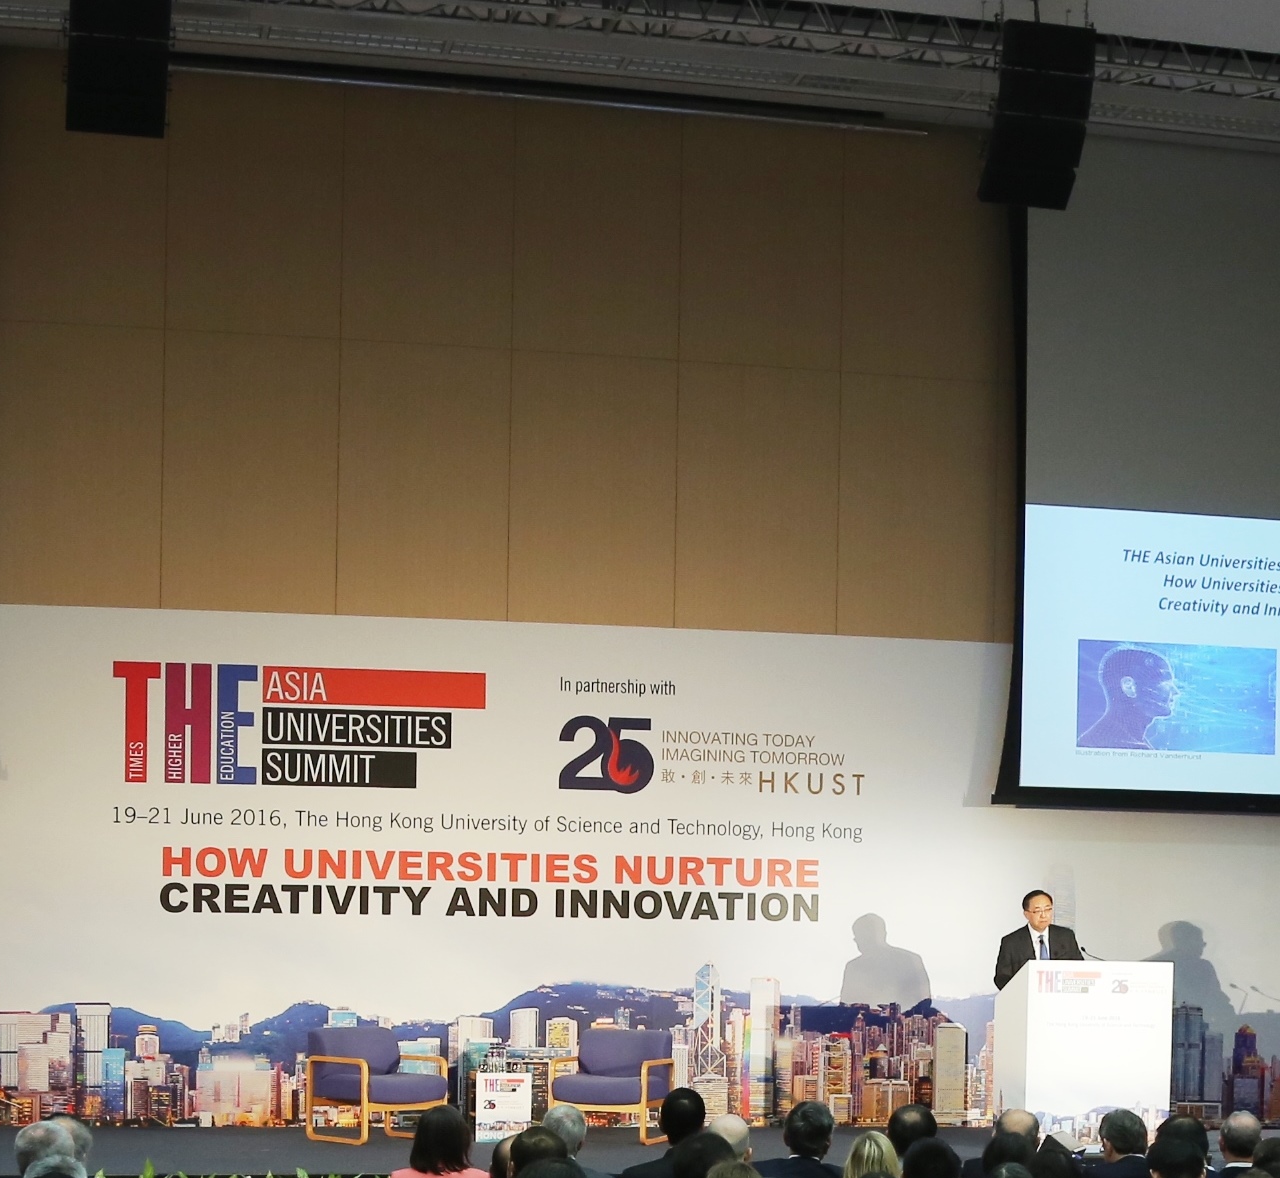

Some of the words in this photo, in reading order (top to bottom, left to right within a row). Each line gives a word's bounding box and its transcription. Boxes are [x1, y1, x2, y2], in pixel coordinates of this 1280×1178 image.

[1122, 548, 1152, 564] THE
[1154, 550, 1195, 567] Asian
[1163, 574, 1197, 589] How
[1158, 596, 1229, 617] Creativity
[1232, 601, 1261, 616] and
[266, 670, 328, 702] ASIA
[560, 676, 572, 692] In
[575, 678, 647, 698] partnership
[650, 679, 677, 696] with
[113, 661, 258, 785] THE
[267, 711, 447, 747] UNIVERSITIES
[661, 730, 759, 747] INNOVATING
[762, 733, 816, 748] TODAY
[128, 741, 144, 780] TIMES
[167, 733, 183, 780] HIGHER
[220, 711, 235, 781] EDUCATION
[558, 715, 655, 795] 25
[661, 747, 746, 764] IMAGINING
[750, 750, 846, 766] TOMORROW
[265, 751, 376, 784] SUMMIT
[758, 770, 866, 796] HKUST
[180, 807, 224, 826] June
[230, 808, 288, 830] 2016,
[295, 809, 329, 828] The
[336, 811, 383, 832] Hong
[390, 812, 434, 834] Kong
[440, 813, 528, 836] University
[534, 815, 551, 832] of
[556, 815, 623, 834] Science
[629, 818, 661, 835] and
[669, 818, 764, 841] Technology,
[771, 821, 815, 842] Hong
[822, 822, 864, 843] Kong
[162, 846, 268, 878] HOW
[283, 848, 599, 884] UNIVERSITIES
[614, 854, 820, 889] NURTURE
[159, 882, 432, 917] CREATIVITY
[444, 886, 539, 918] AND
[555, 888, 820, 922] INNOVATION
